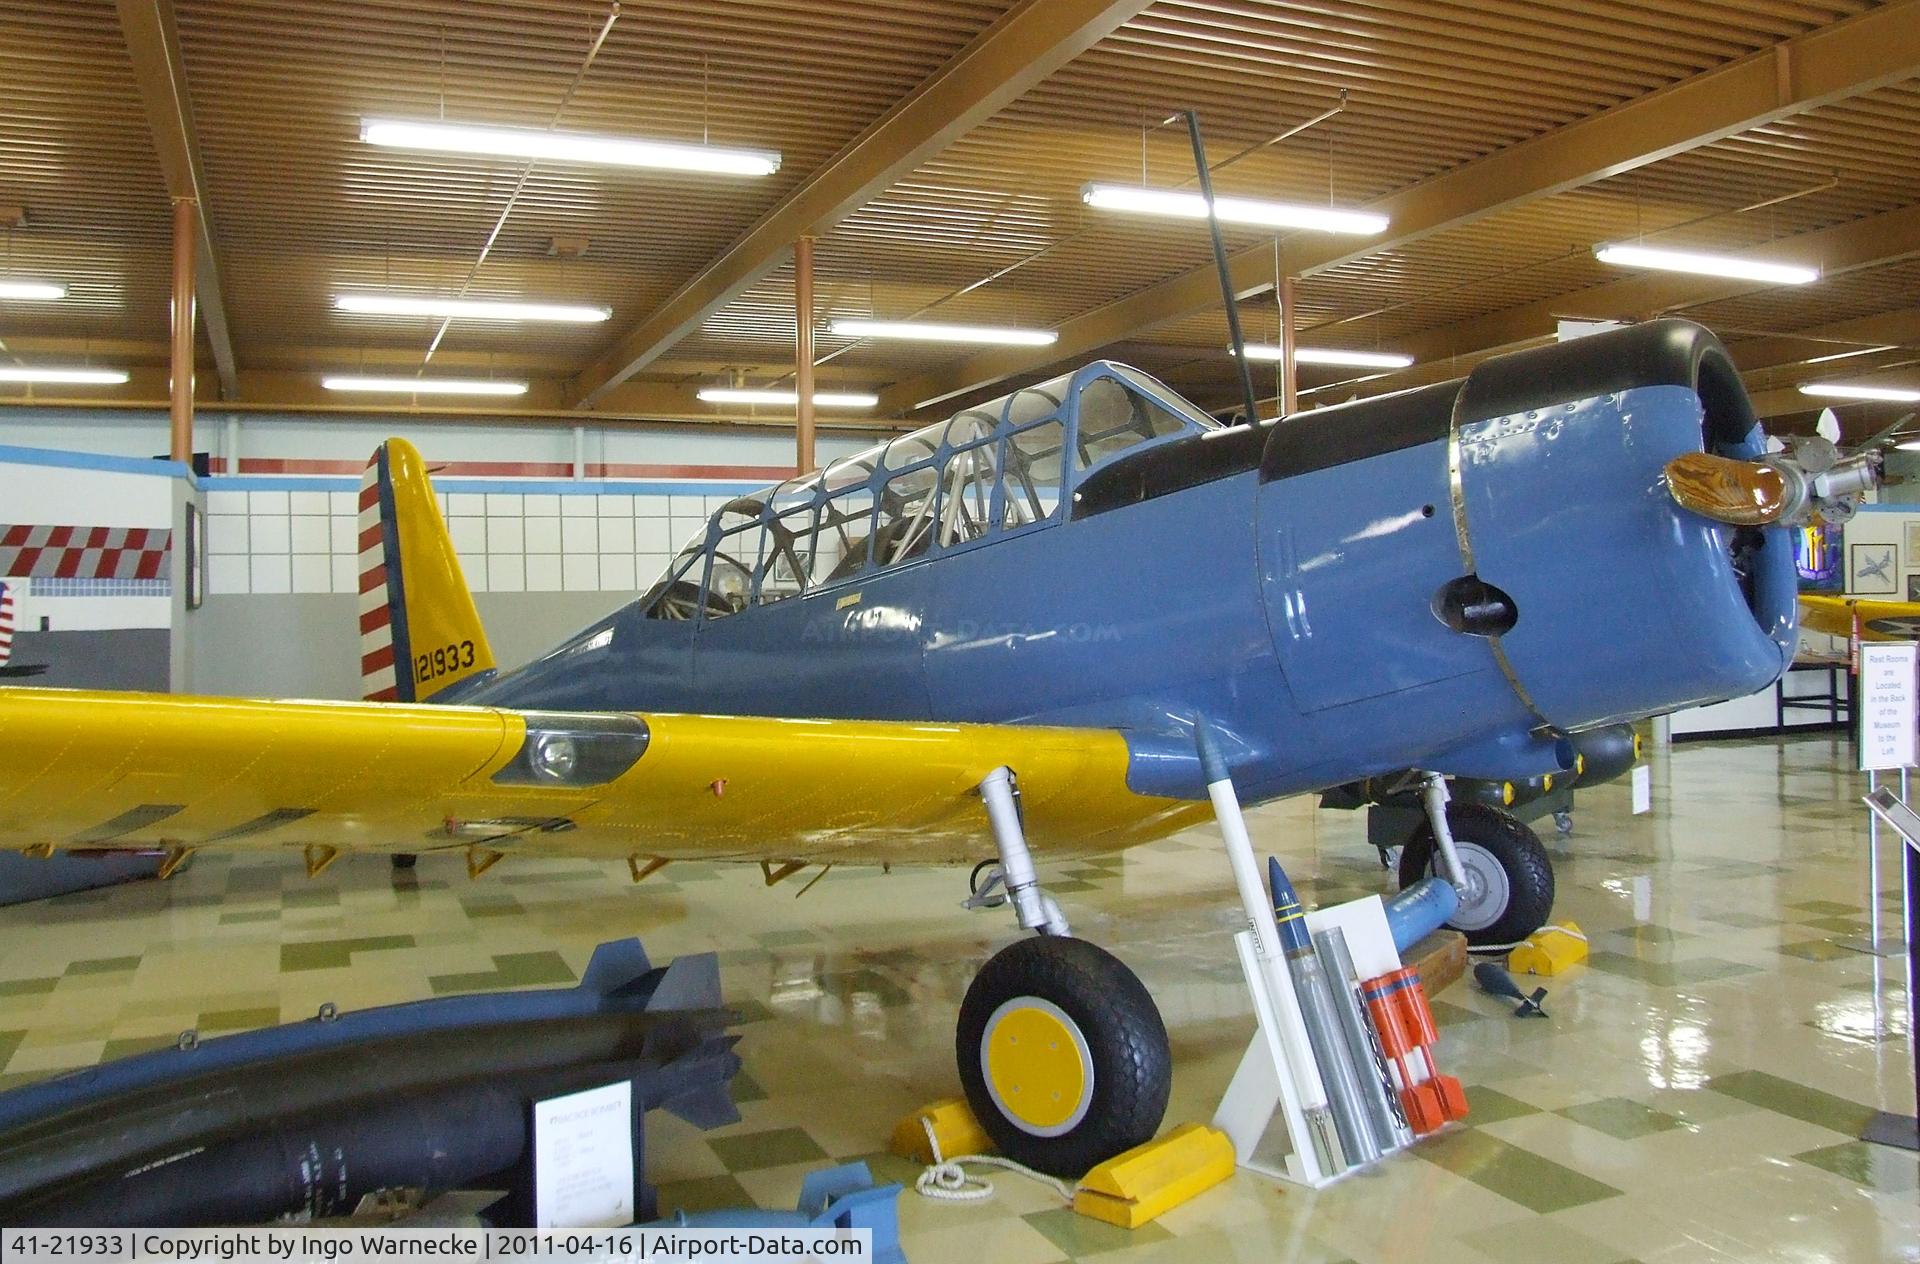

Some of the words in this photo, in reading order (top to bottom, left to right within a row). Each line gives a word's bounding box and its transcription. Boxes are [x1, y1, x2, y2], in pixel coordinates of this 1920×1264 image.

[414, 640, 475, 684] 121933
[1869, 655, 1885, 664] Rest
[1886, 654, 1909, 663] Rooms
[1876, 681, 1902, 690] Located
[1871, 695, 1877, 703] in
[1878, 695, 1889, 703] the
[1890, 694, 1906, 703] Back
[1879, 708, 1886, 716] of
[1887, 707, 1898, 716] the
[1874, 721, 1901, 729] Museum
[1878, 735, 1885, 743] to
[1886, 735, 1897, 743] the
[1881, 747, 1896, 756] Left
